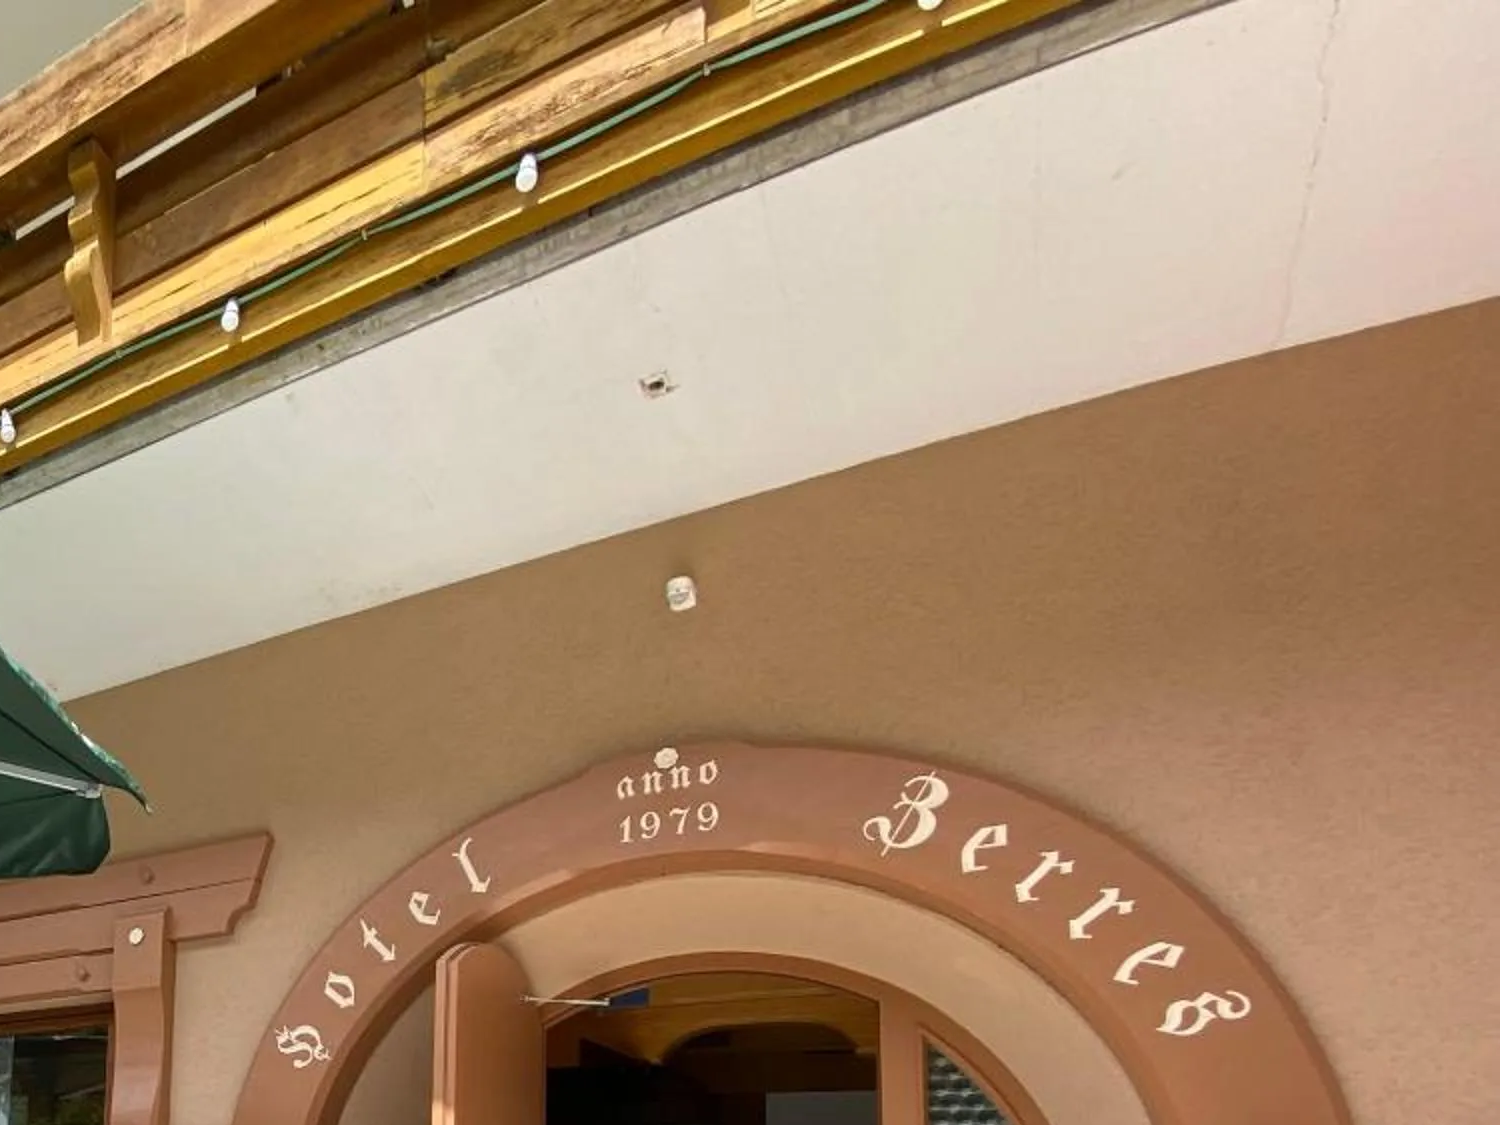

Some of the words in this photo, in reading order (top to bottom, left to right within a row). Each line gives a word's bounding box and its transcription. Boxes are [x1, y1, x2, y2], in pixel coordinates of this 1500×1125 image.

[617, 759, 719, 800] anno
[619, 801, 719, 844] 1979
[275, 837, 492, 1069] Hotel
[862, 771, 1252, 1037] Berres
